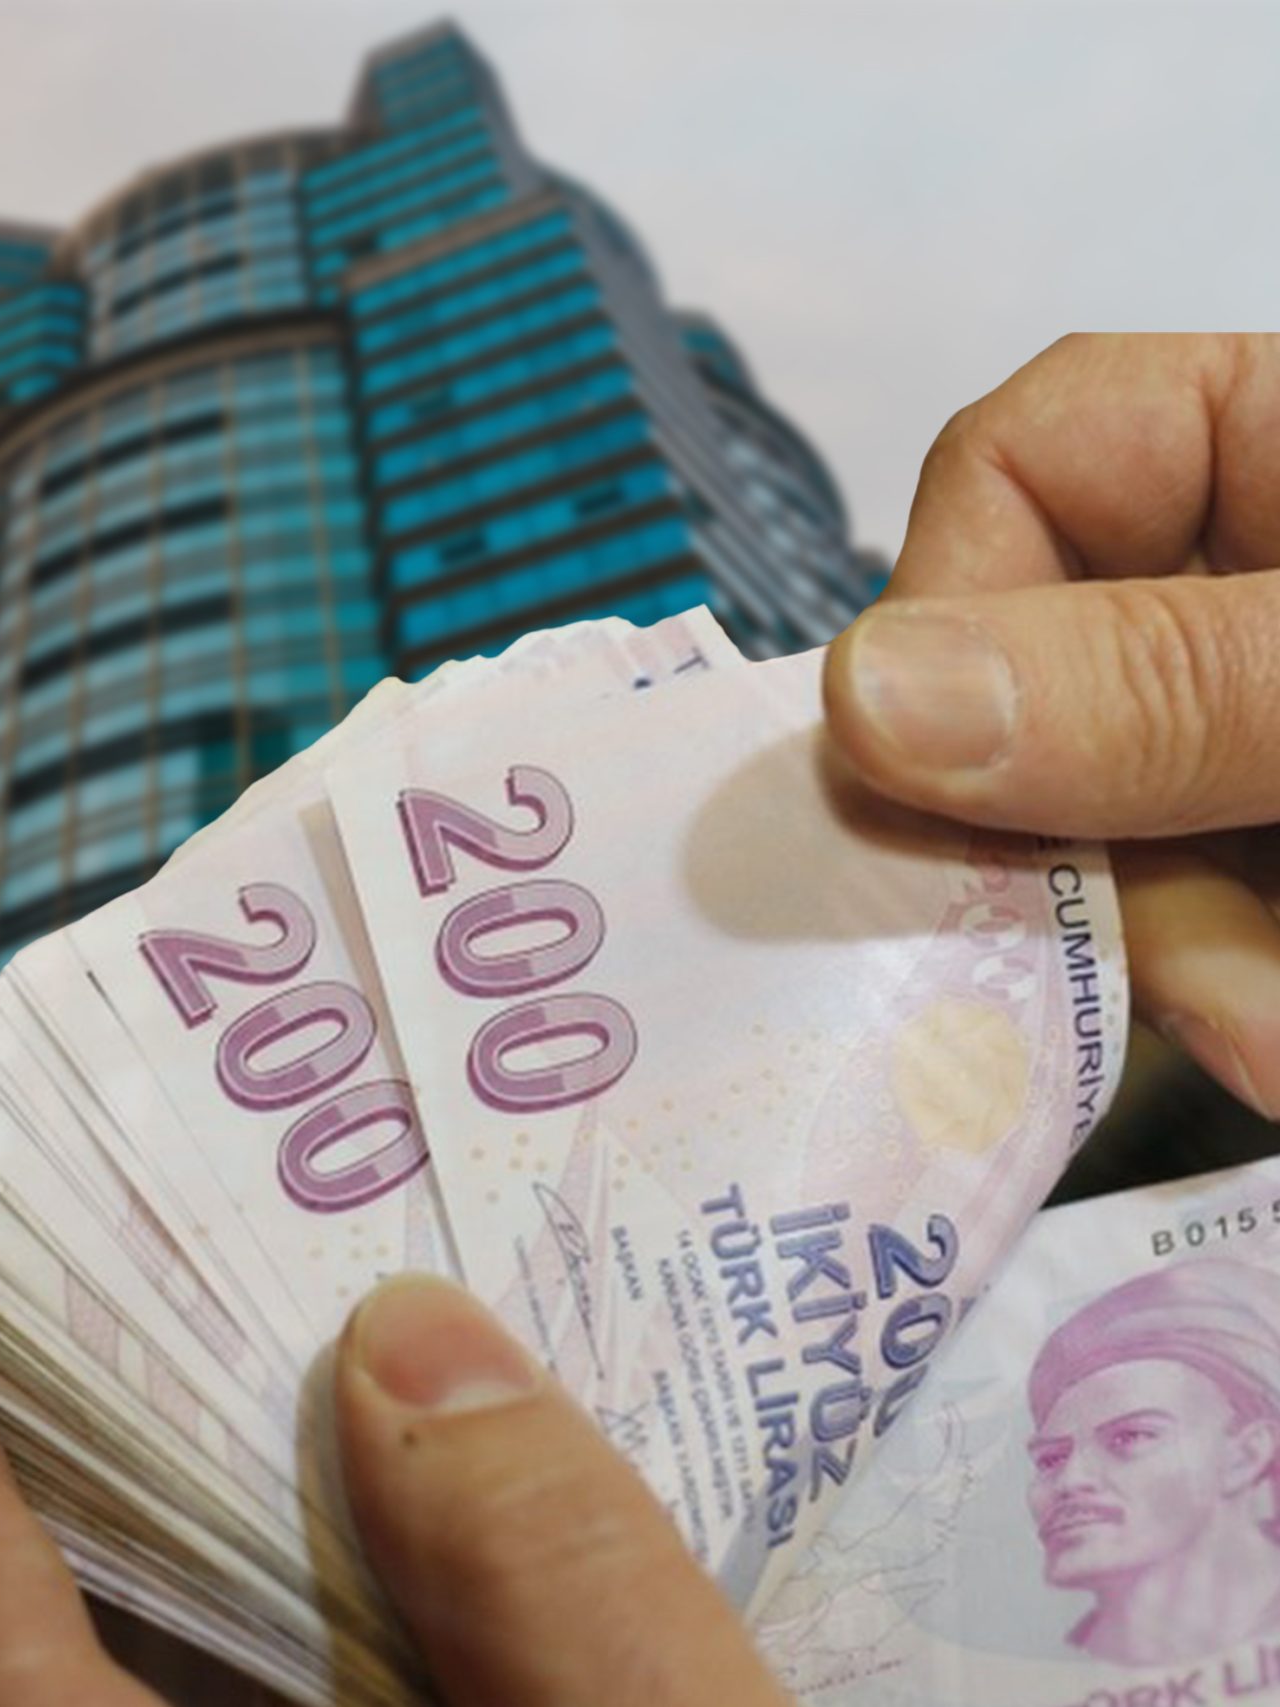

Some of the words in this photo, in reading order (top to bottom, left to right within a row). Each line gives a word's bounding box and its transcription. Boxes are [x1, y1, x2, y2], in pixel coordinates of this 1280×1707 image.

[138, 881, 431, 1214] 200
[395, 763, 639, 1114] 200
[1047, 862, 1105, 1148] CUMHURİYE
[700, 1182, 780, 1347] TÜRK
[769, 1201, 873, 1503] İKİYÜZ
